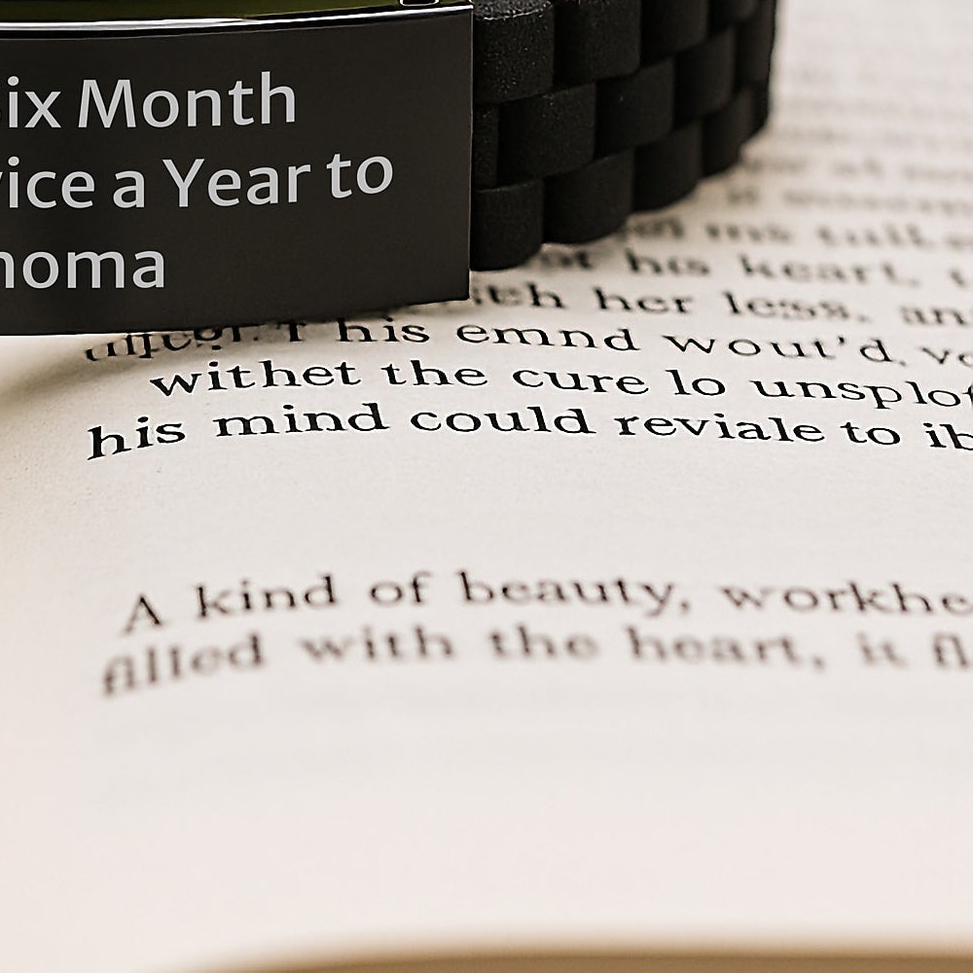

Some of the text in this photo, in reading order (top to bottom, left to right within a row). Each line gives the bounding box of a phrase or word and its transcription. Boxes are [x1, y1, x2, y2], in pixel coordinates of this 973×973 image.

[77, 71, 297, 129] Month
[113, 169, 146, 209] a
[162, 157, 311, 207] Year
[327, 153, 394, 199] to
[593, 286, 693, 315] her
[337, 317, 429, 343] his
[457, 324, 641, 352] emnd
[150, 360, 361, 397] withet
[381, 359, 488, 386] the
[512, 368, 649, 395] cure
[87, 416, 186, 460] his
[213, 403, 390, 437] mind
[410, 403, 595, 434] could
[614, 413, 824, 442] reviale
[840, 421, 901, 446] to
[123, 594, 164, 635] A
[195, 573, 339, 619] kind
[369, 571, 431, 605] of
[460, 570, 691, 617] beauty,
[301, 624, 454, 662] with
[489, 624, 599, 661] the
